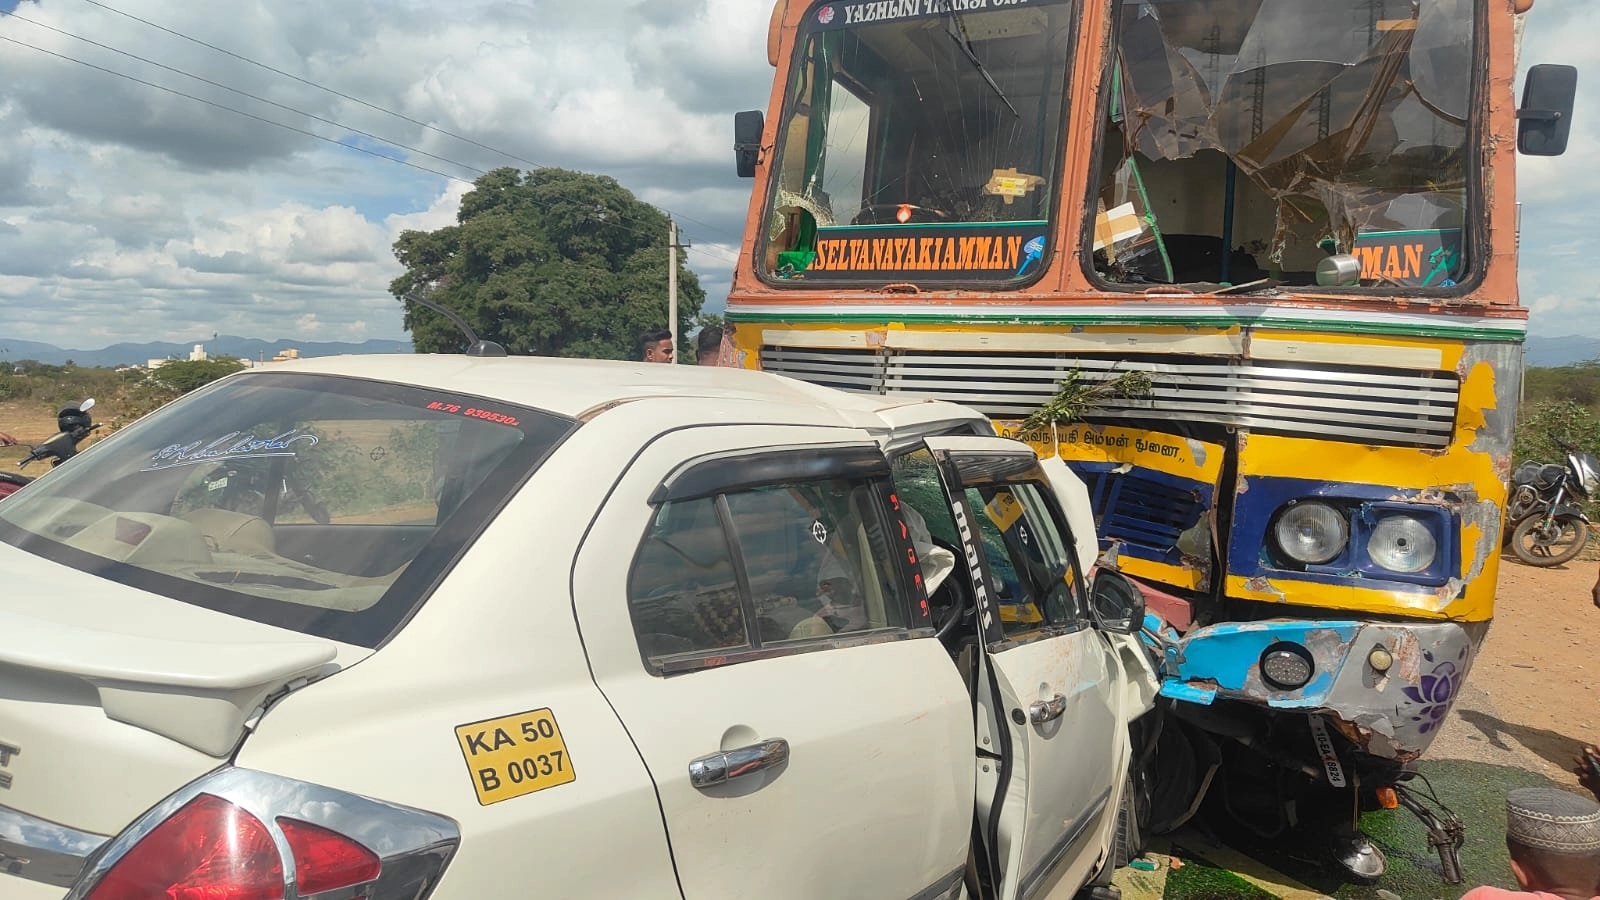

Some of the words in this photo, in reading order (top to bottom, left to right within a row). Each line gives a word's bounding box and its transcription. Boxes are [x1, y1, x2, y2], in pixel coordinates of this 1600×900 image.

[924, 0, 1028, 14] TRANS
[806, 236, 1022, 270] SELVANAYAKIAMMAN
[1084, 431, 1129, 448] அம்மன்
[465, 727, 517, 756] KA
[521, 718, 554, 743] 50
[478, 767, 502, 792] B
[507, 750, 563, 784] 0037
